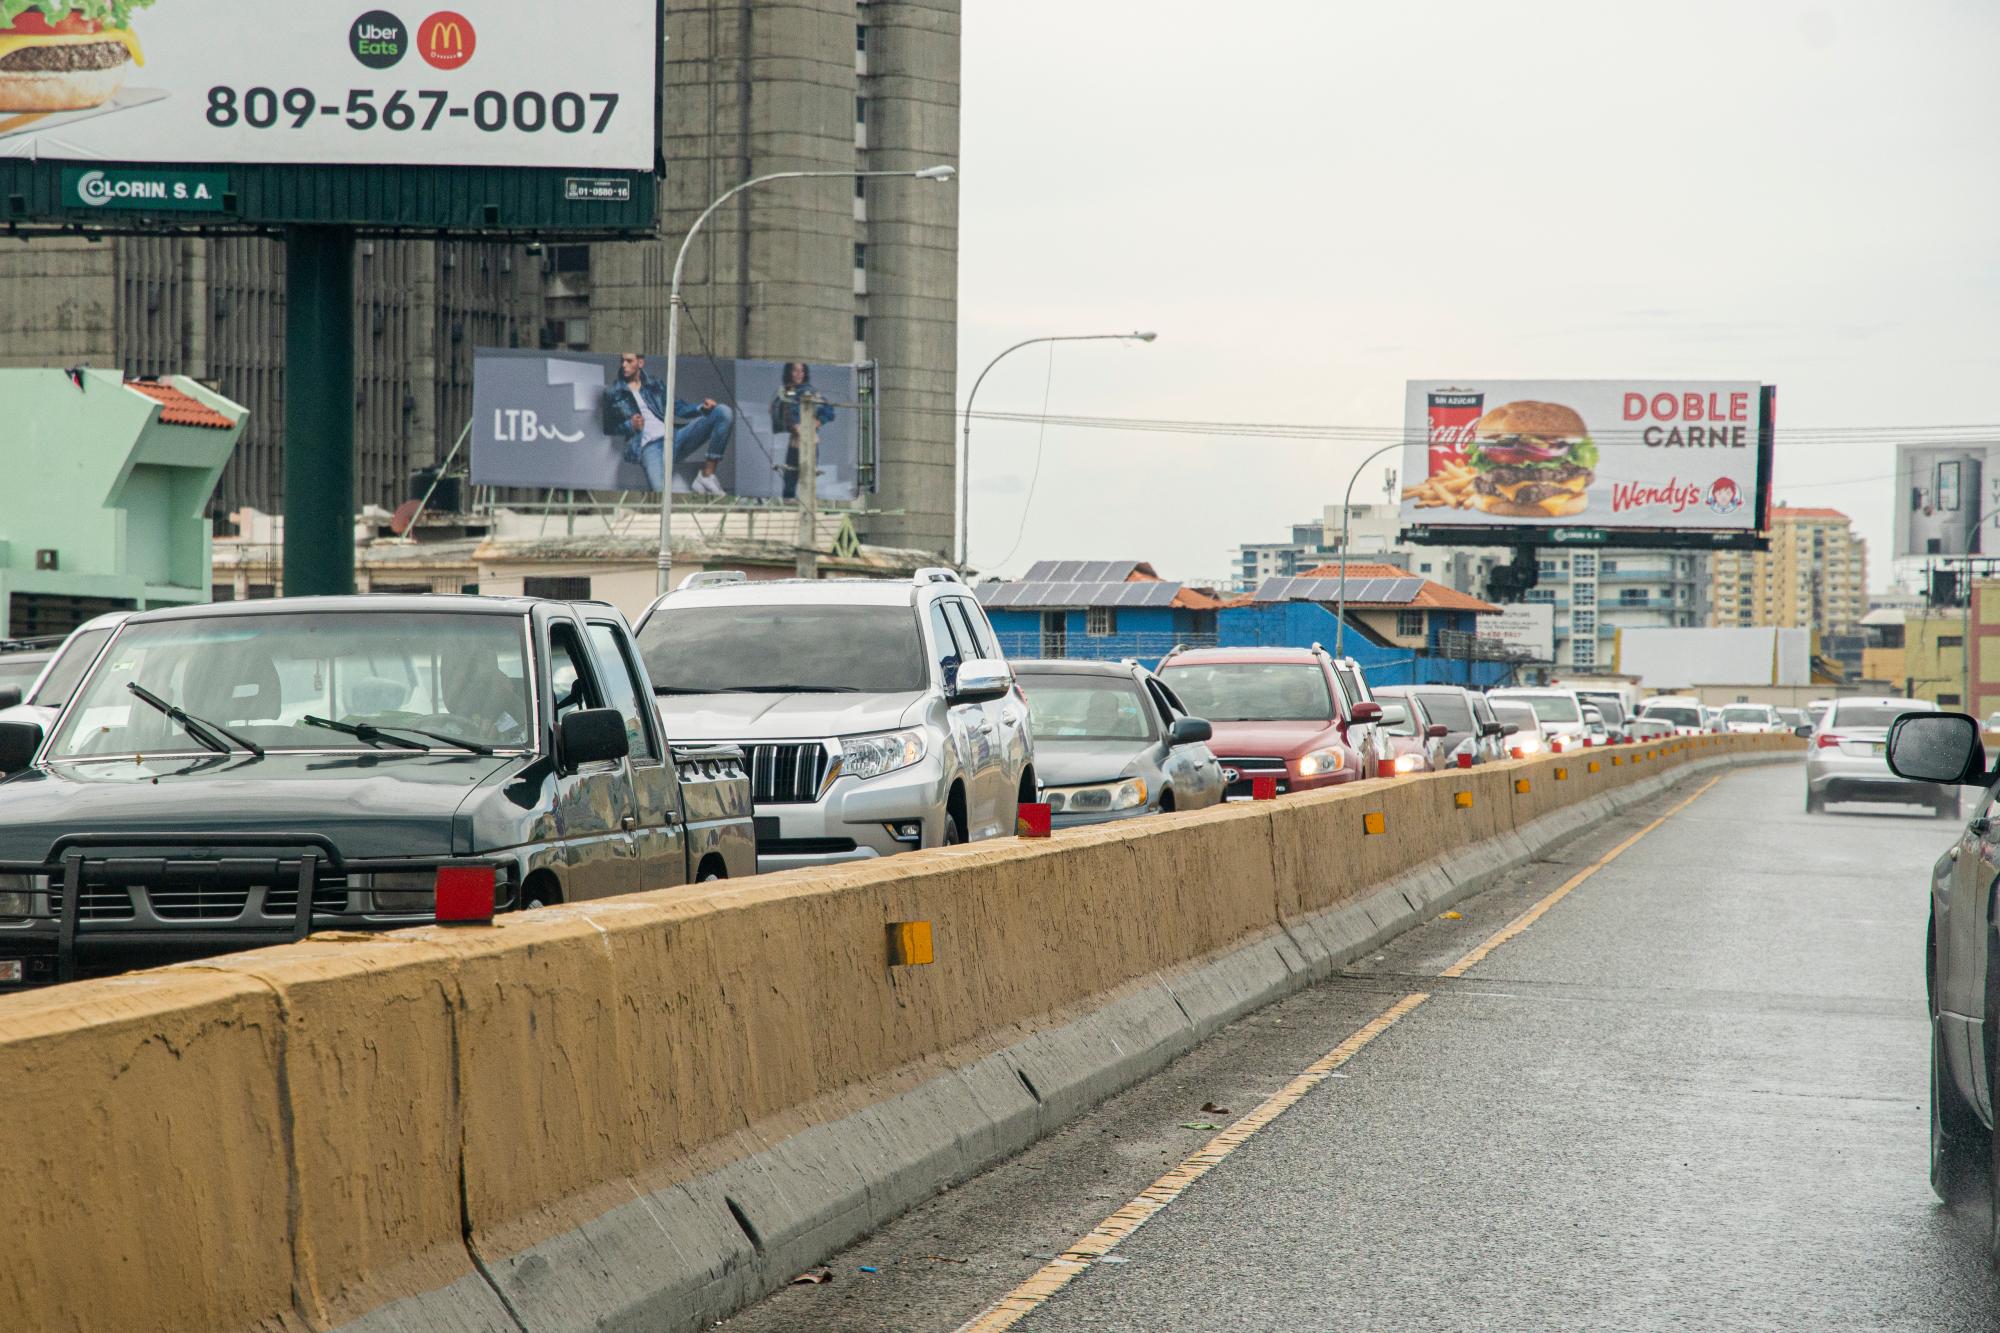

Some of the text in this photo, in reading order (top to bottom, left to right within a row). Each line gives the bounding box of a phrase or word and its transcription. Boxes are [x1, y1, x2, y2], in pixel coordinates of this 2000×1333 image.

[358, 24, 398, 40] Uber
[358, 40, 398, 55] Eats
[206, 85, 620, 135] 809-567-0007
[1623, 391, 1748, 422] DOBLE
[1643, 425, 1747, 448] CARNE
[1613, 477, 1700, 513] Wendy's
